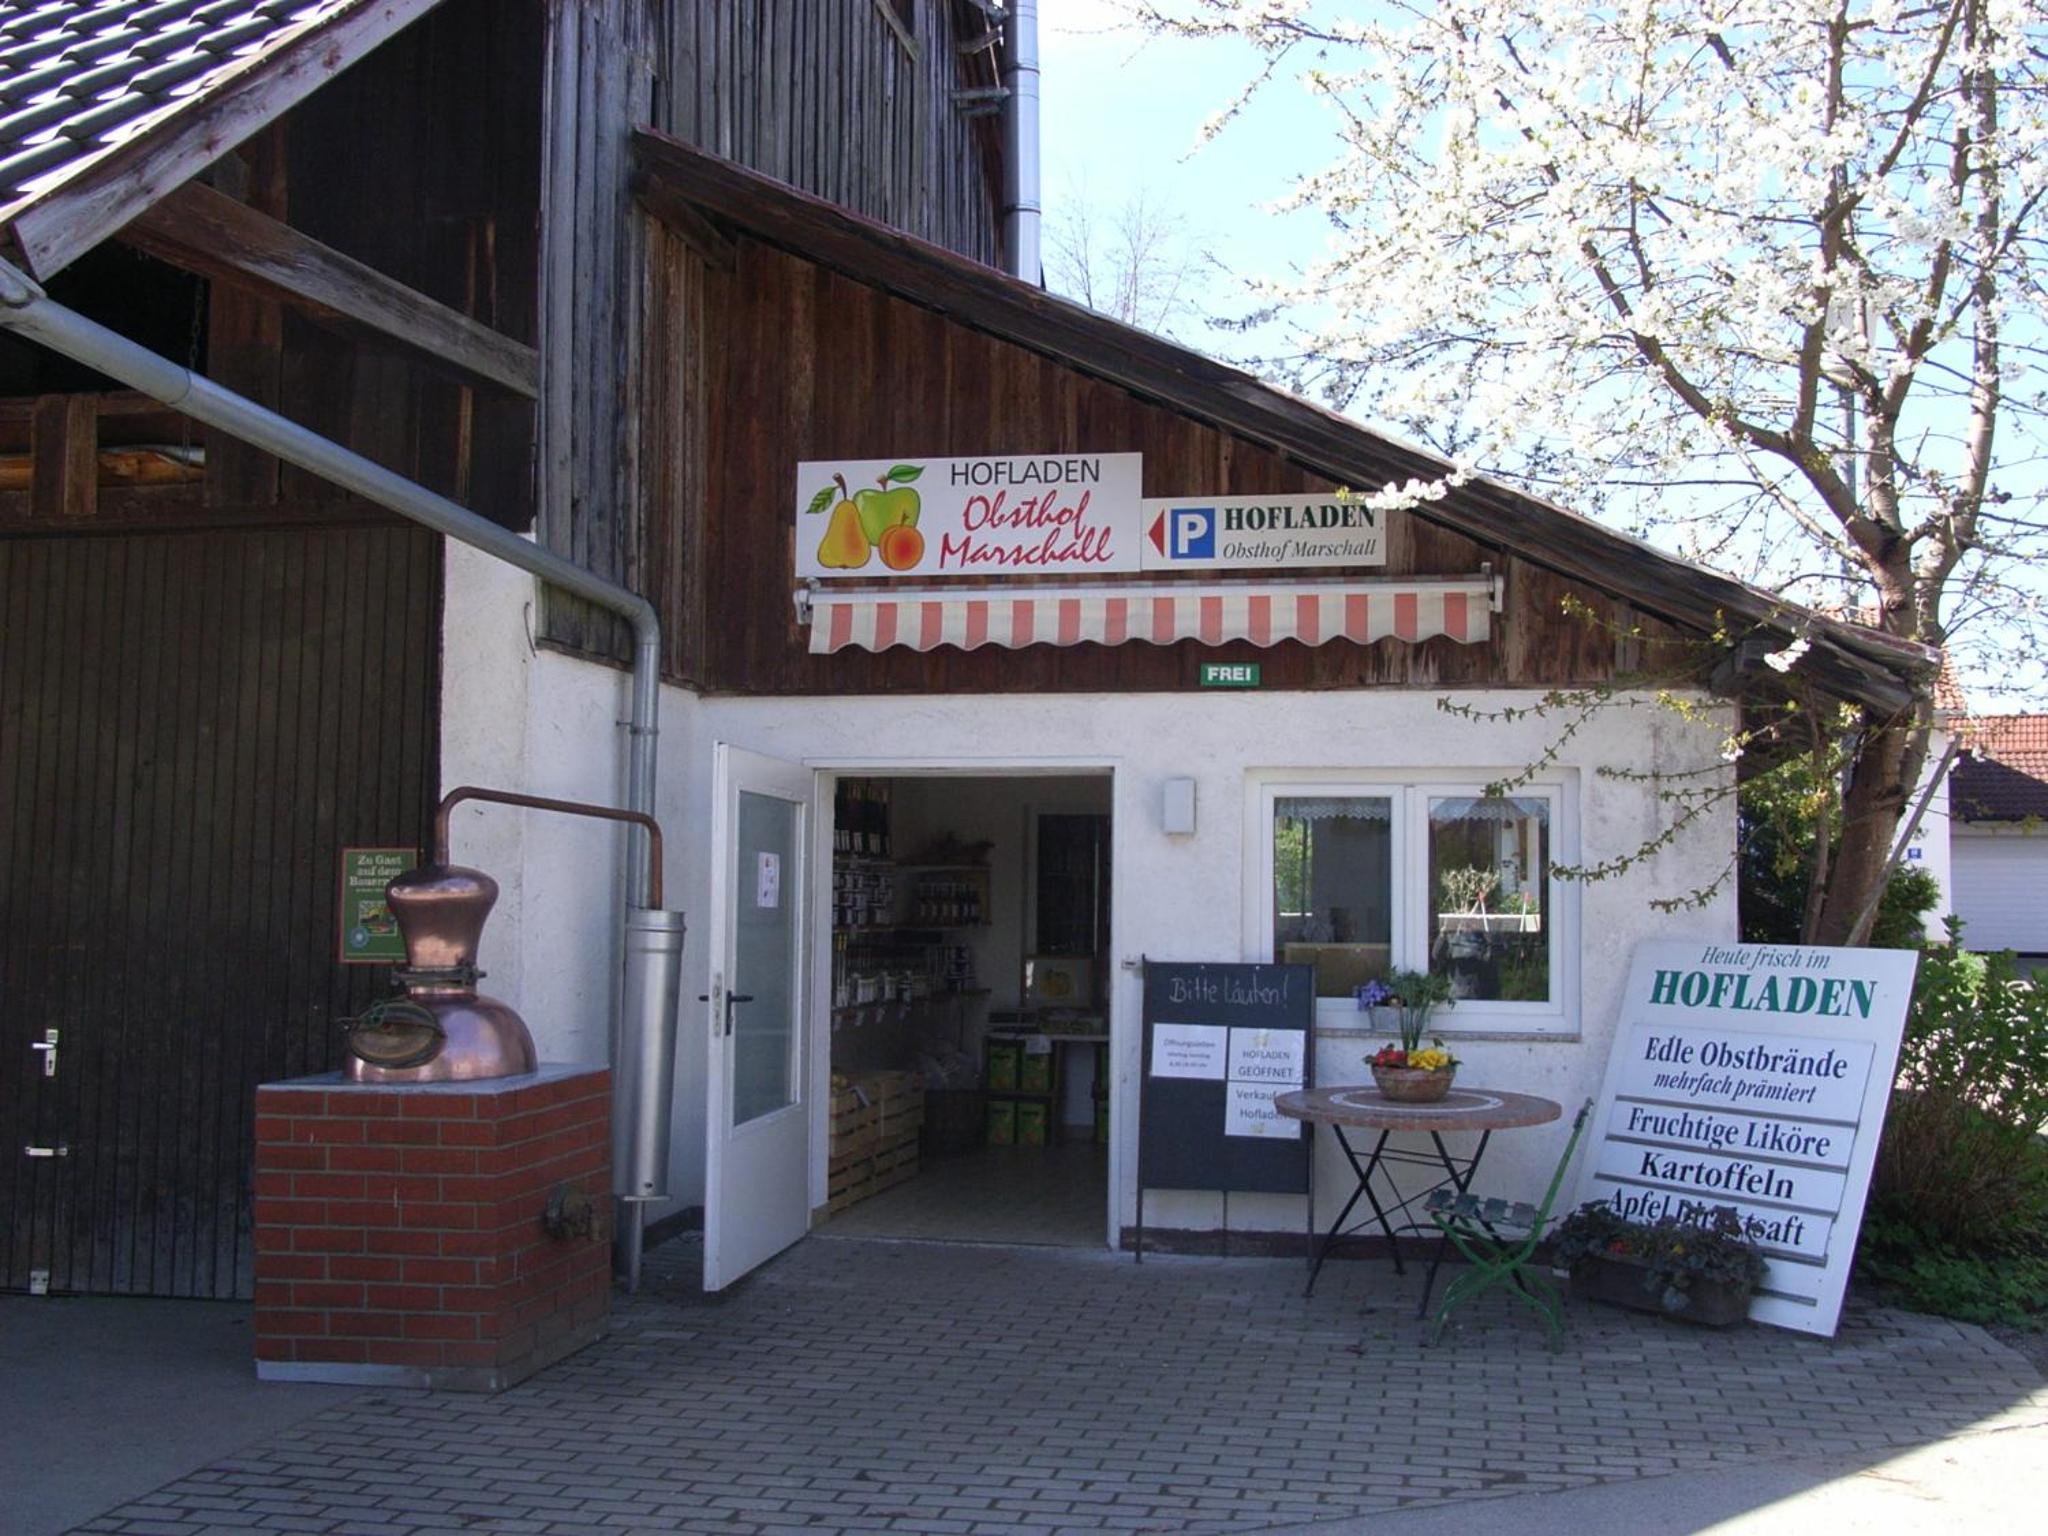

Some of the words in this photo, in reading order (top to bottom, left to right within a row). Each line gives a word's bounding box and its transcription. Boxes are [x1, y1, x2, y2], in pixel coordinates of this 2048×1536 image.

[951, 459, 1100, 486] HOFLADEN
[963, 489, 1091, 538] Obsthof
[1224, 505, 1375, 531] HOFLADEN
[1177, 513, 1208, 554] P
[939, 527, 1115, 569] Marschall
[1223, 539, 1292, 562] Obsthof
[1292, 538, 1377, 558] Marschall
[1207, 666, 1251, 681] FREI
[357, 865, 377, 876] auf
[375, 854, 402, 865] Gast
[1701, 946, 1750, 966] Heute
[1751, 947, 1801, 971] frisch
[1806, 950, 1831, 970] im
[1169, 976, 1218, 1004] Bitte
[1649, 970, 1878, 1019] HOFLADEN
[1242, 1050, 1290, 1060] HOFLADEN
[1644, 1035, 1693, 1063] Edle
[1701, 1042, 1848, 1079] Obstbrände
[1238, 1065, 1293, 1078] GEÖFFNET
[1654, 1072, 1732, 1097] mehrfach
[1731, 1080, 1816, 1104] prämiert
[1627, 1107, 1738, 1150] Fruchtige
[1744, 1122, 1831, 1158] Liköre
[1640, 1152, 1794, 1200] Kartoffeln
[1607, 1187, 1670, 1220] Apfel
[1676, 1199, 1805, 1246] Dirtsaft
